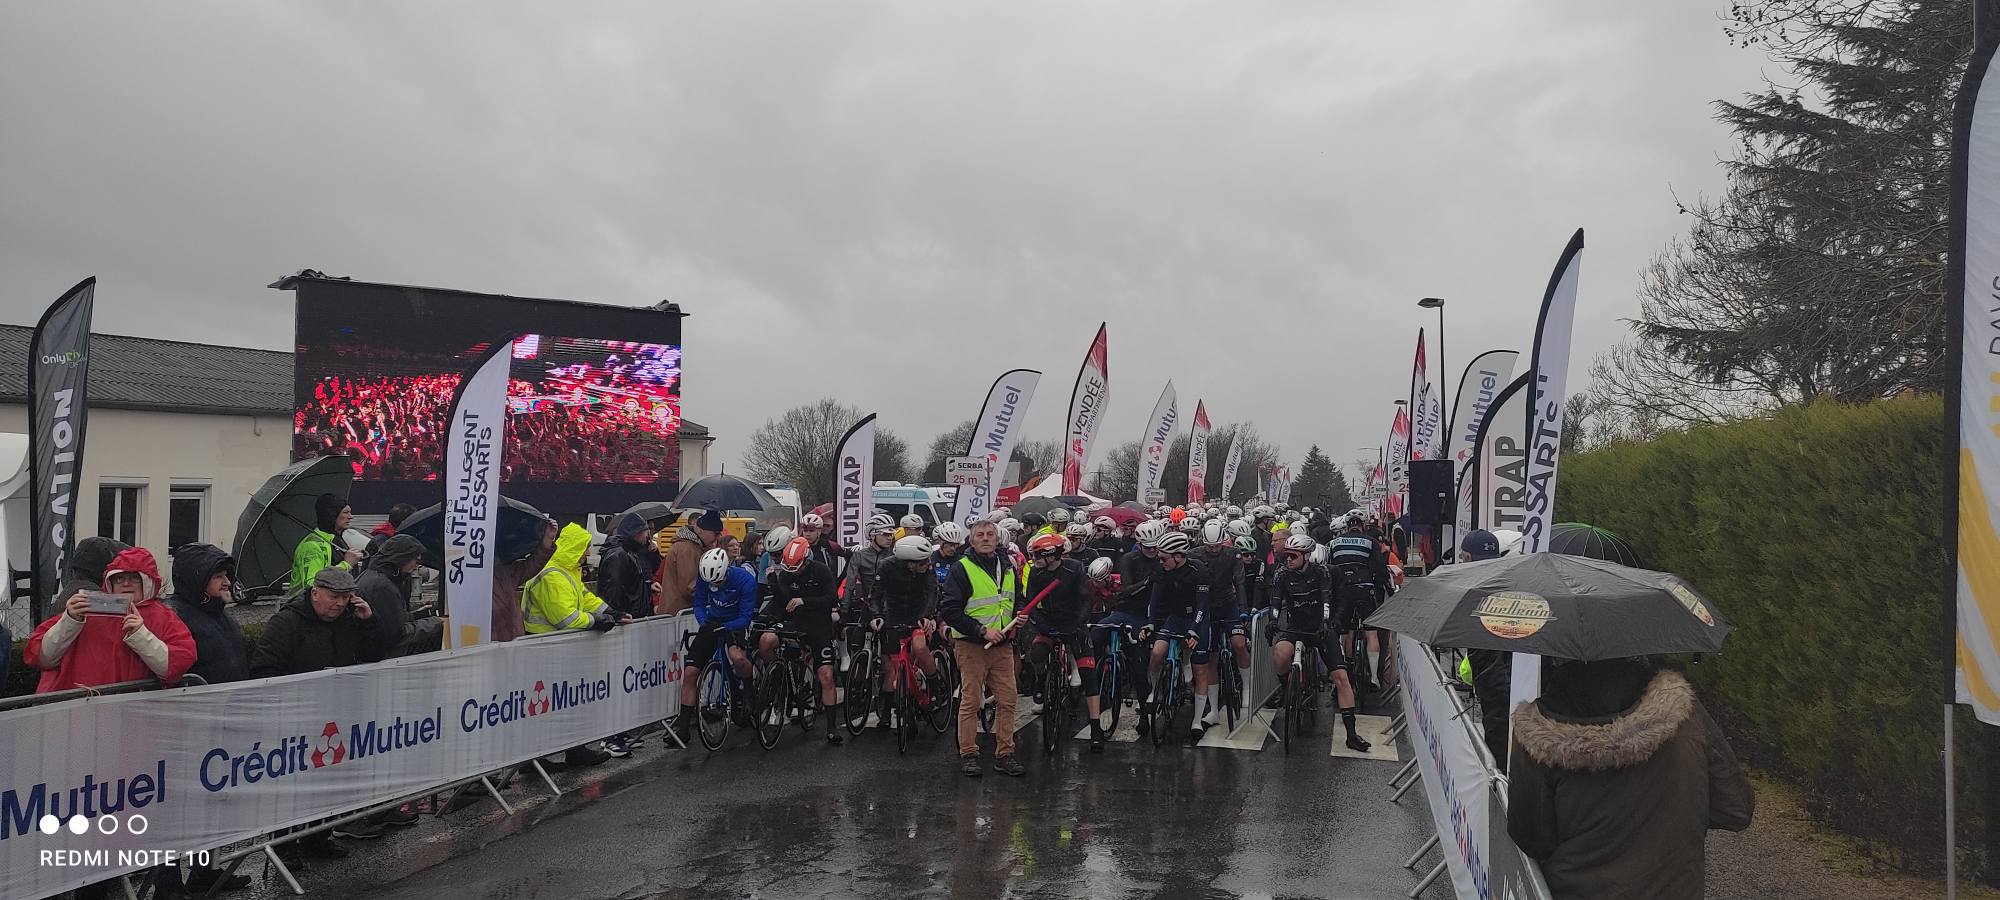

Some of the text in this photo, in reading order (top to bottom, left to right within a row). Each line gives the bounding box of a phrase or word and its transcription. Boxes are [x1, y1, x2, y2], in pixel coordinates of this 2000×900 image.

[1073, 376, 1102, 435] VENDÉE
[1153, 399, 1176, 445] Mutu
[1464, 370, 1497, 443] Mutuel
[469, 426, 492, 521] ESSARTS
[953, 475, 965, 484] 25
[957, 462, 983, 470] SERBA
[964, 385, 1022, 530] Mutuel Créd
[1192, 432, 1206, 467] VENDÉE
[1494, 436, 1526, 532] TRAP
[843, 456, 861, 549] FULTRAP
[0, 663, 667, 840] Mutuel Crédit Mutuel Crédit Mutuel Crédit
